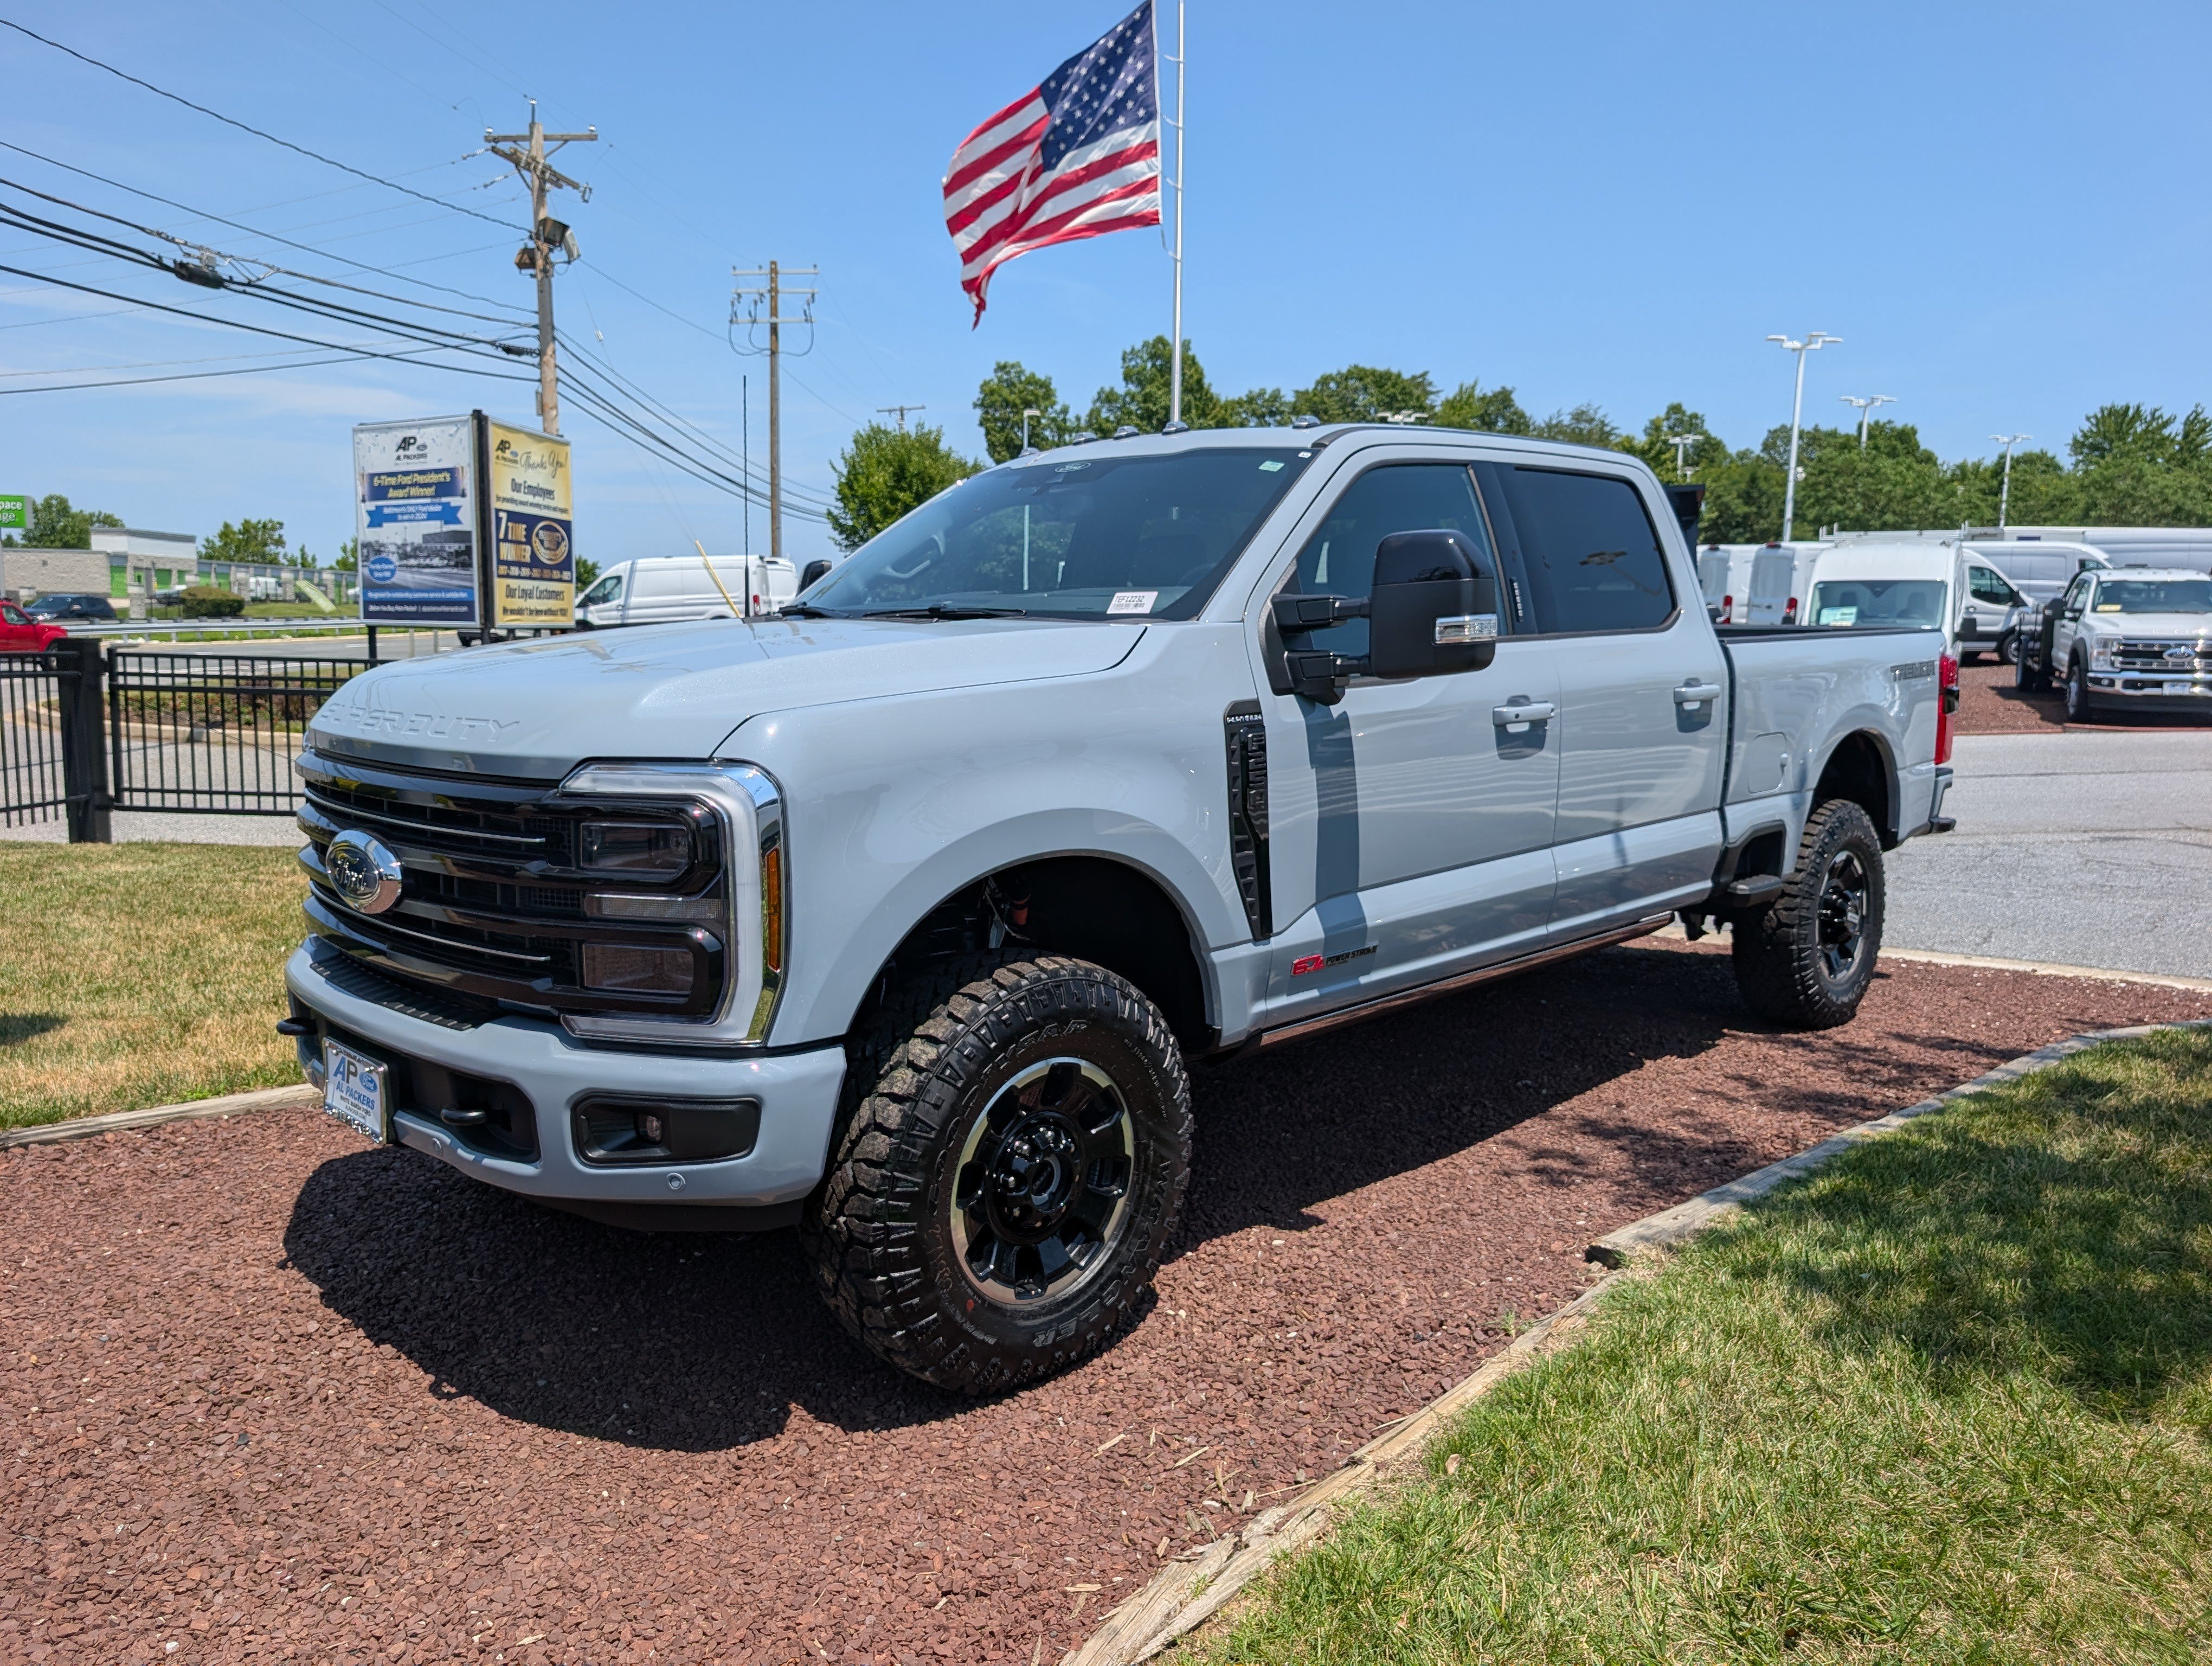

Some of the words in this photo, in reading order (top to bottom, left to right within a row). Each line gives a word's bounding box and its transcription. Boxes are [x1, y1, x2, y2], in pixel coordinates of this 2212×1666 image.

[395, 437, 417, 452] AP
[496, 439, 511, 454] AP
[397, 473, 413, 485] Ford
[413, 471, 452, 484] President's
[387, 488, 408, 498] Award
[511, 478, 522, 493] Our
[523, 479, 555, 501] Employees
[498, 511, 508, 540] 7
[507, 521, 527, 542] TIME
[499, 541, 532, 563] WINNER
[505, 584, 517, 599] Our
[518, 585, 535, 602] Loyal
[535, 585, 565, 601] Customers
[1890, 659, 1935, 682] TREMOR
[401, 713, 520, 742] DUTY
[333, 1055, 358, 1084] AP
[336, 1081, 344, 1093] AL
[345, 1085, 375, 1110] PACKERS
